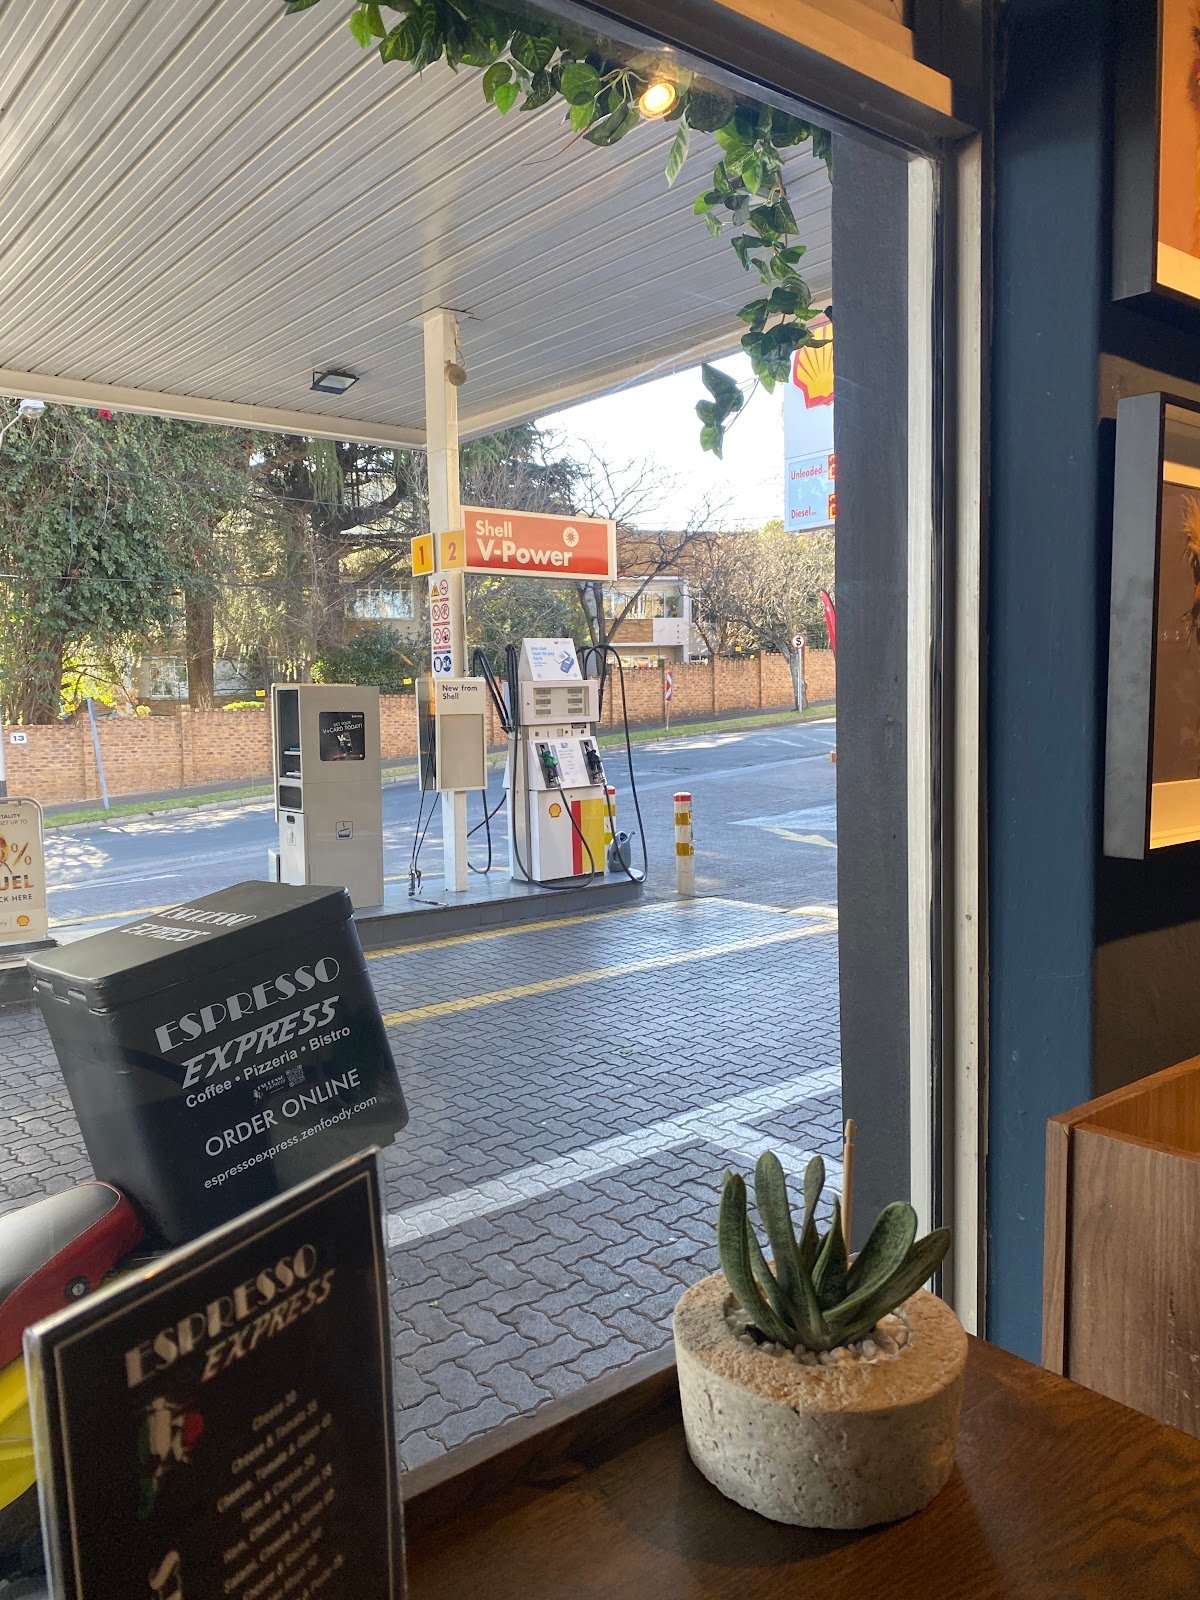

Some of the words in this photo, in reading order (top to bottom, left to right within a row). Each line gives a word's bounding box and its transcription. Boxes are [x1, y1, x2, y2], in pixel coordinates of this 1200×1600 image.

[791, 464, 823, 480] Unleaded
[791, 506, 811, 519] Diesel
[475, 519, 513, 538] Shell
[419, 545, 425, 566] 1
[448, 541, 457, 561] 2
[476, 538, 573, 567] V-Power
[442, 684, 459, 693] New
[442, 692, 459, 700] Shell
[11, 893, 33, 902] HERE
[154, 956, 340, 1053] ESPRESSO
[180, 995, 340, 1089] EXPRESS
[185, 1078, 233, 1109] Coffee
[243, 1050, 298, 1081] Pizzeria
[308, 1026, 351, 1051] Bistro
[205, 1109, 279, 1157] ORDER
[281, 1068, 361, 1118] ONLINE
[203, 1095, 378, 1190] espressoexpress.zenfoody.com
[124, 1243, 317, 1389] ESPRESSO
[201, 1267, 336, 1383] EXPRESS
